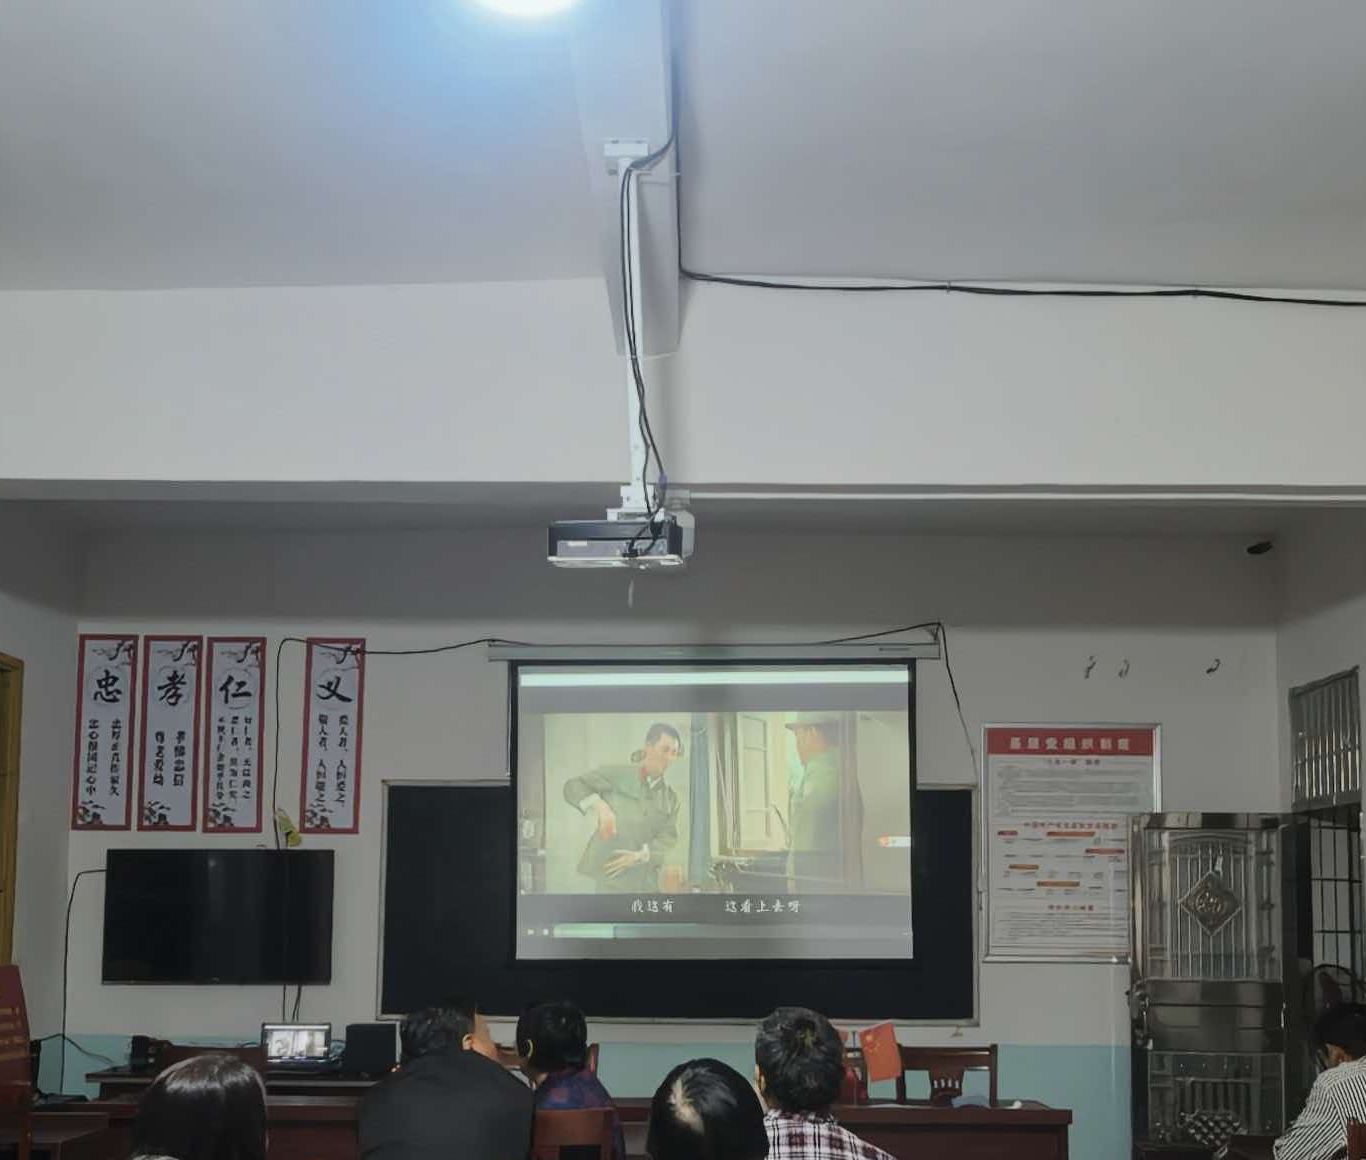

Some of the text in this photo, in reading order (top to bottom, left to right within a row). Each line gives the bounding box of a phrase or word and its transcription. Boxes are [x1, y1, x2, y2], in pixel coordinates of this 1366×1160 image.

[93, 669, 123, 704] 忠
[157, 670, 188, 706] 孝
[219, 675, 252, 705] 仁
[316, 676, 353, 703] 义
